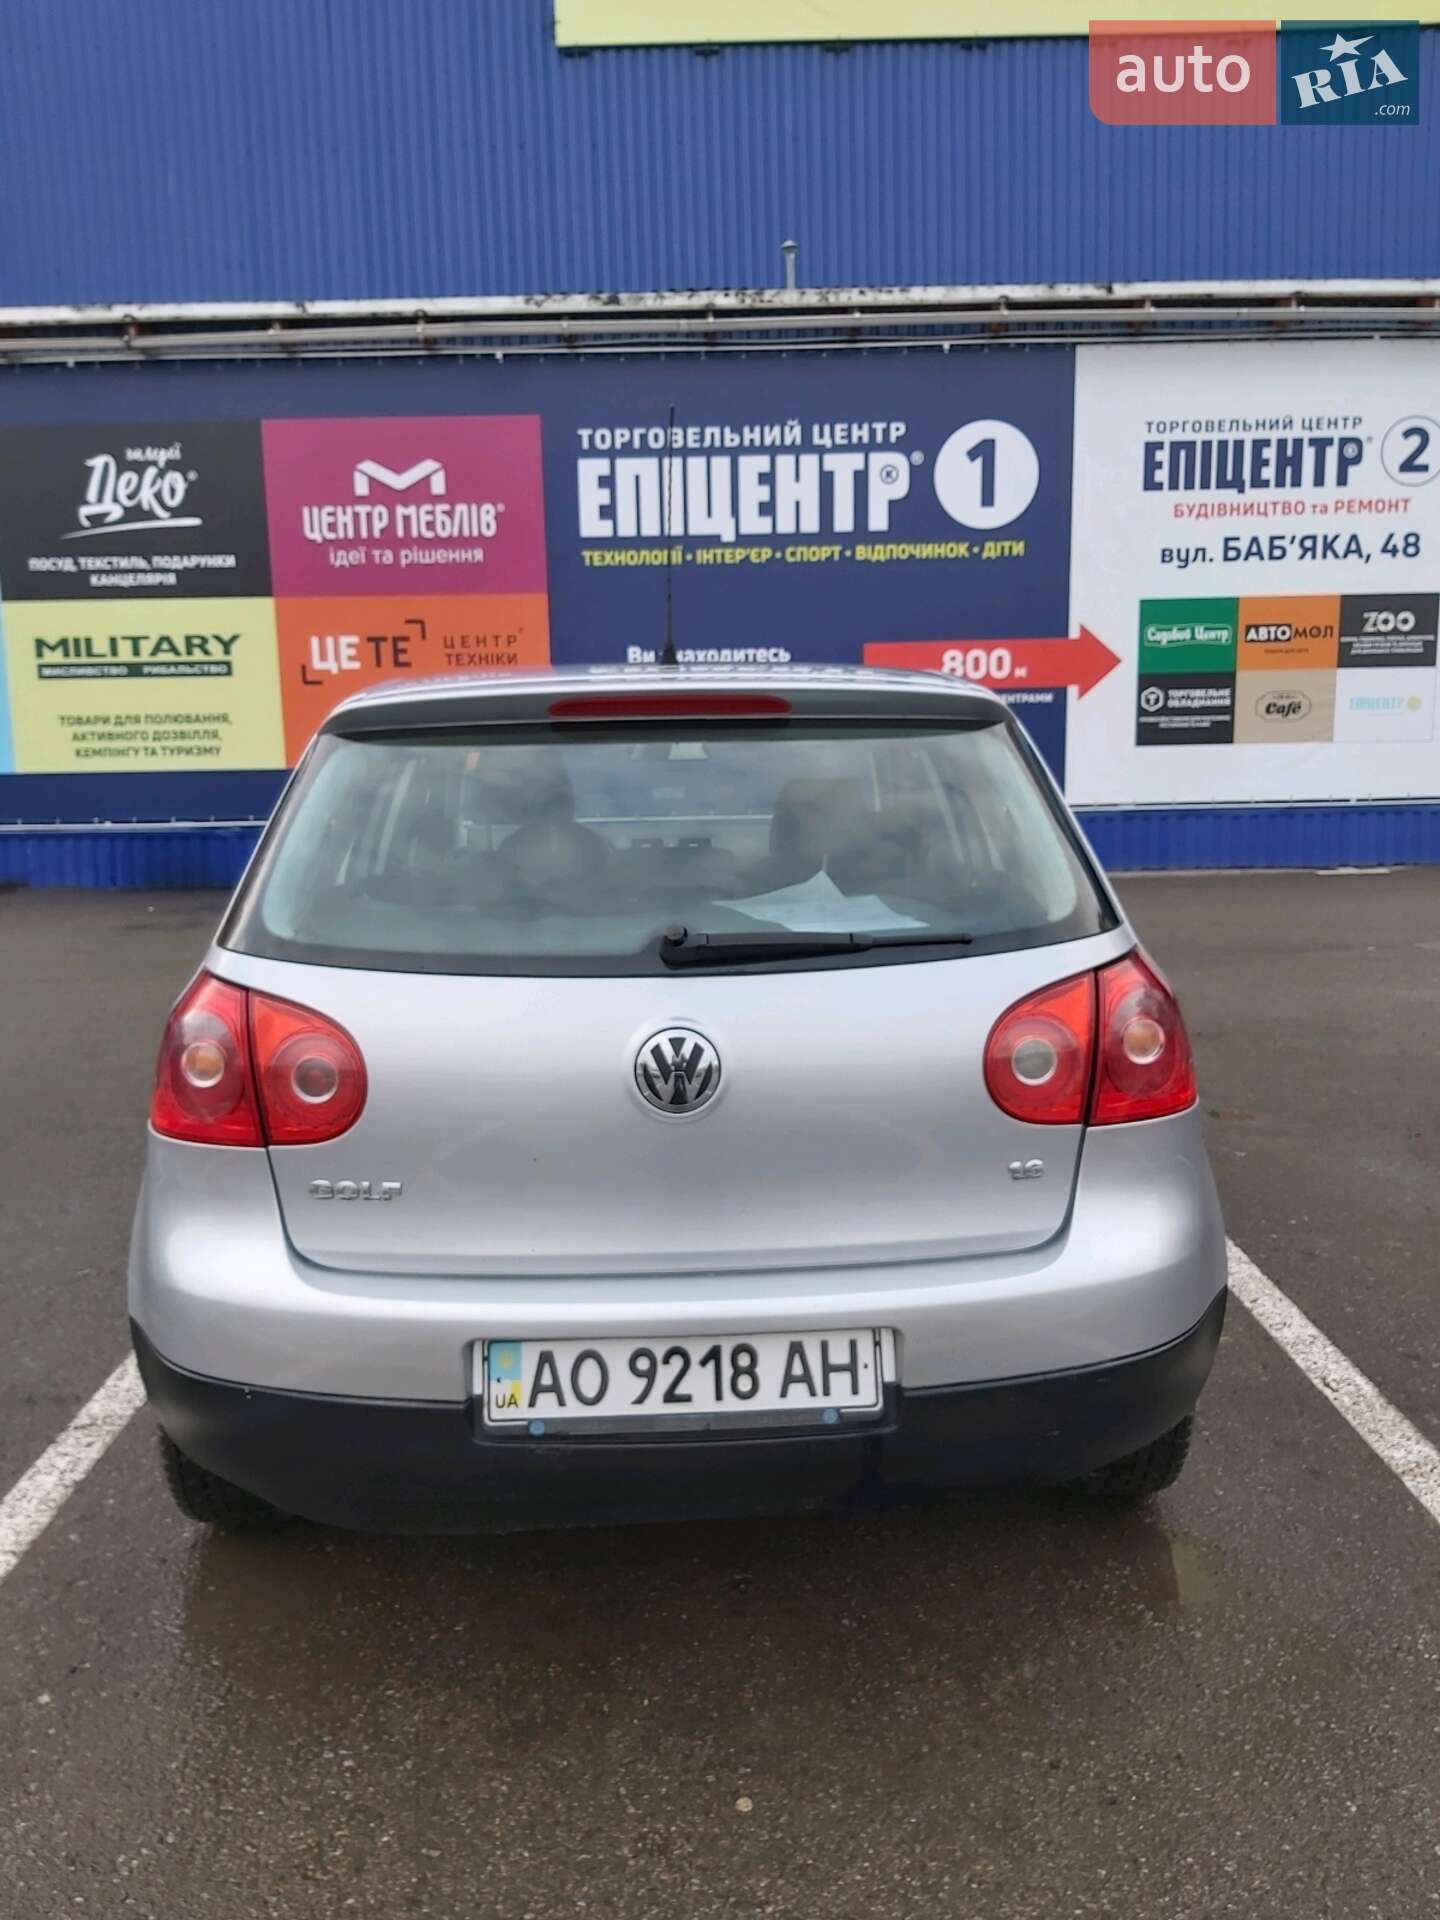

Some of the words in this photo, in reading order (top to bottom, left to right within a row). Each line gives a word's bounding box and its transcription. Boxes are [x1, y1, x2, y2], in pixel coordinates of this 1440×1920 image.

[577, 420, 802, 450] ТОРГОВЕЛЬНИЙ
[812, 421, 907, 448] ЦЕНТР
[1146, 414, 1294, 434] ТОРГОВЕЛЬНИЙ
[1301, 416, 1363, 431] ЦЕНТР
[1398, 426, 1431, 473] 2
[964, 437, 996, 508] 1
[1142, 437, 1364, 494] ЕПІЦЕНТР
[78, 453, 187, 528] Деко
[576, 451, 911, 543] ЕПІЦЕНТР
[1173, 500, 1305, 520] БУДІВНИЦТВО
[1311, 503, 1328, 516] та
[1334, 498, 1411, 515] РЕМОНТ
[302, 505, 389, 544] ЦЕНТР
[396, 503, 497, 539] МЕБЛІВ
[329, 546, 367, 567] ідеї
[371, 548, 394, 564] та
[400, 546, 484, 568] рішення
[785, 545, 841, 562] СПОРТ
[855, 542, 968, 561] ВІДПОЧИНОК
[983, 541, 1025, 559] ДІТИ
[1161, 548, 1213, 568] вул.
[1380, 532, 1421, 558] 48
[78, 556, 150, 570] ТЕКСТИЛЬ,
[152, 554, 236, 569] ПОДАРУНКИ
[89, 572, 177, 587] КАНЦЕЛЯРІЯ
[1362, 610, 1416, 633] ZOO
[35, 634, 241, 659] MILITARY
[443, 634, 518, 650] ЦЕНТР
[310, 635, 361, 674] ЦЕ
[366, 636, 412, 668] ТЕ
[445, 652, 518, 667] ТЕХНІКИ
[627, 645, 656, 663] Ви
[659, 647, 791, 662] находитесь
[941, 648, 1011, 680] 800
[1265, 701, 1302, 717] Café
[59, 714, 111, 726] ТОВАРИ
[113, 714, 142, 727] ДЛЯ
[72, 731, 149, 742] АКТИВНОГО
[75, 747, 140, 758] КЕМПІНГУ
[143, 746, 159, 757] ТА
[161, 745, 221, 757] ТУРИЗМУ
[309, 1179, 401, 1200] GOLF
[528, 1349, 609, 1407] AO
[628, 1342, 760, 1404] 9218
[779, 1339, 860, 1397] AH
[495, 1393, 519, 1409] UA
